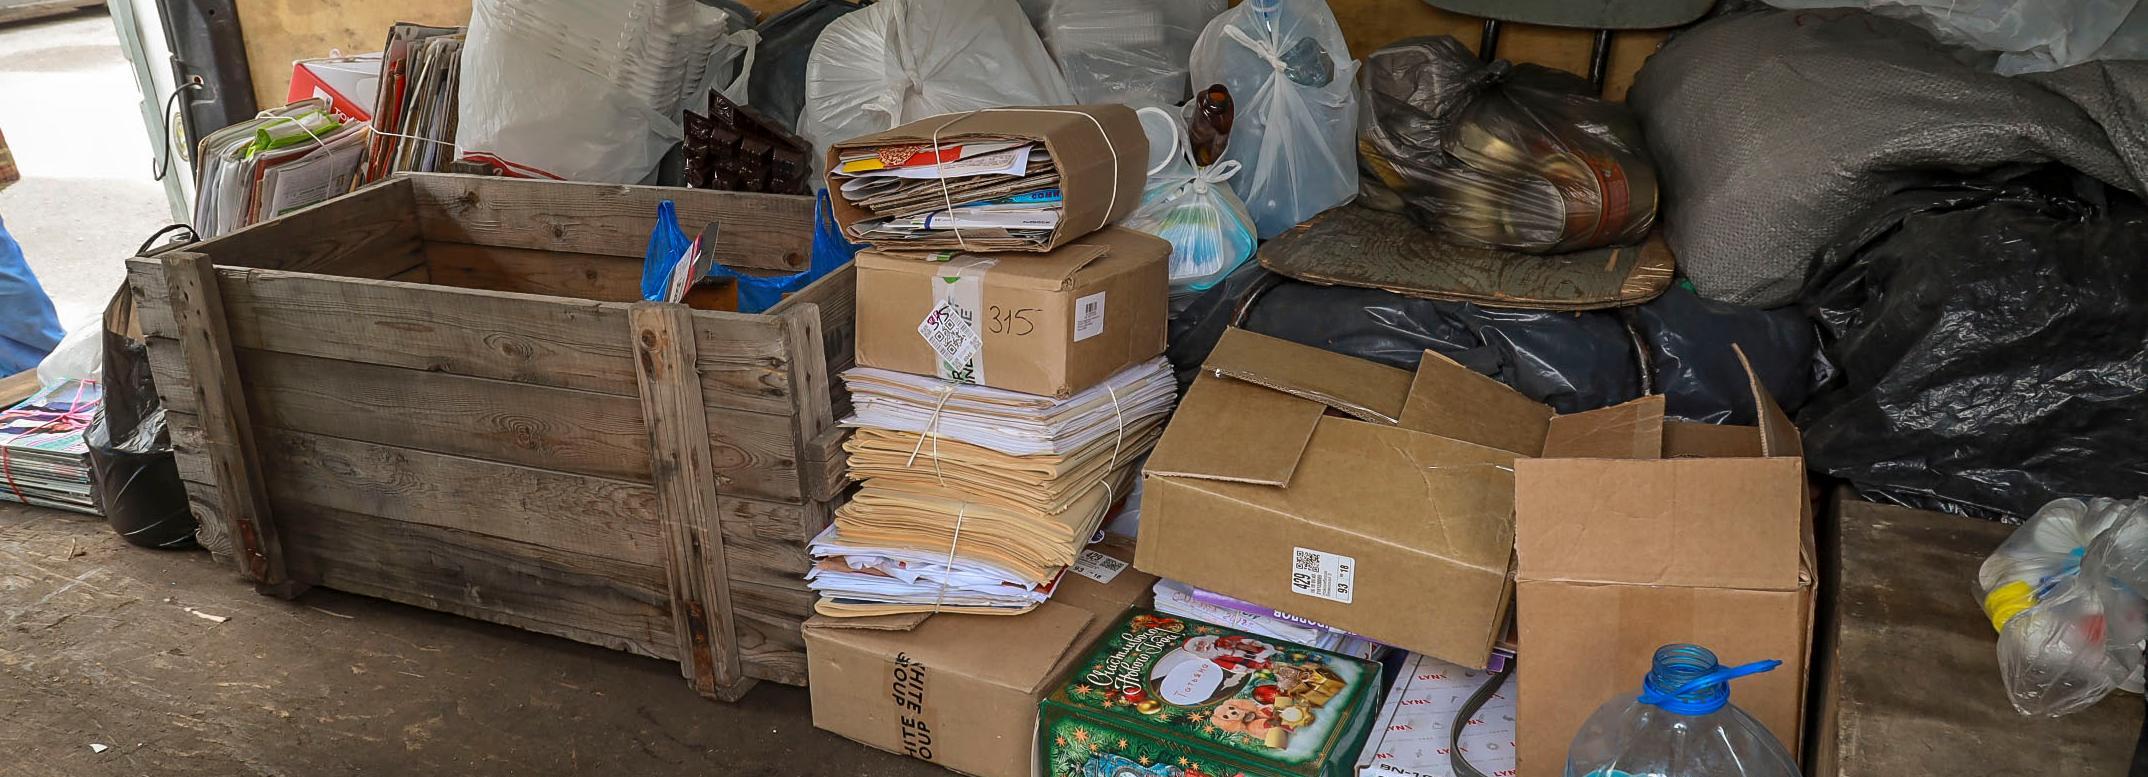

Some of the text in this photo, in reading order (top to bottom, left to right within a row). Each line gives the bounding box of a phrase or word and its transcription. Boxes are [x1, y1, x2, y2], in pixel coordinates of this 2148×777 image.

[989, 305, 1043, 336] 315
[1293, 572, 1311, 590] 429
[1337, 564, 1349, 594] 93 18
